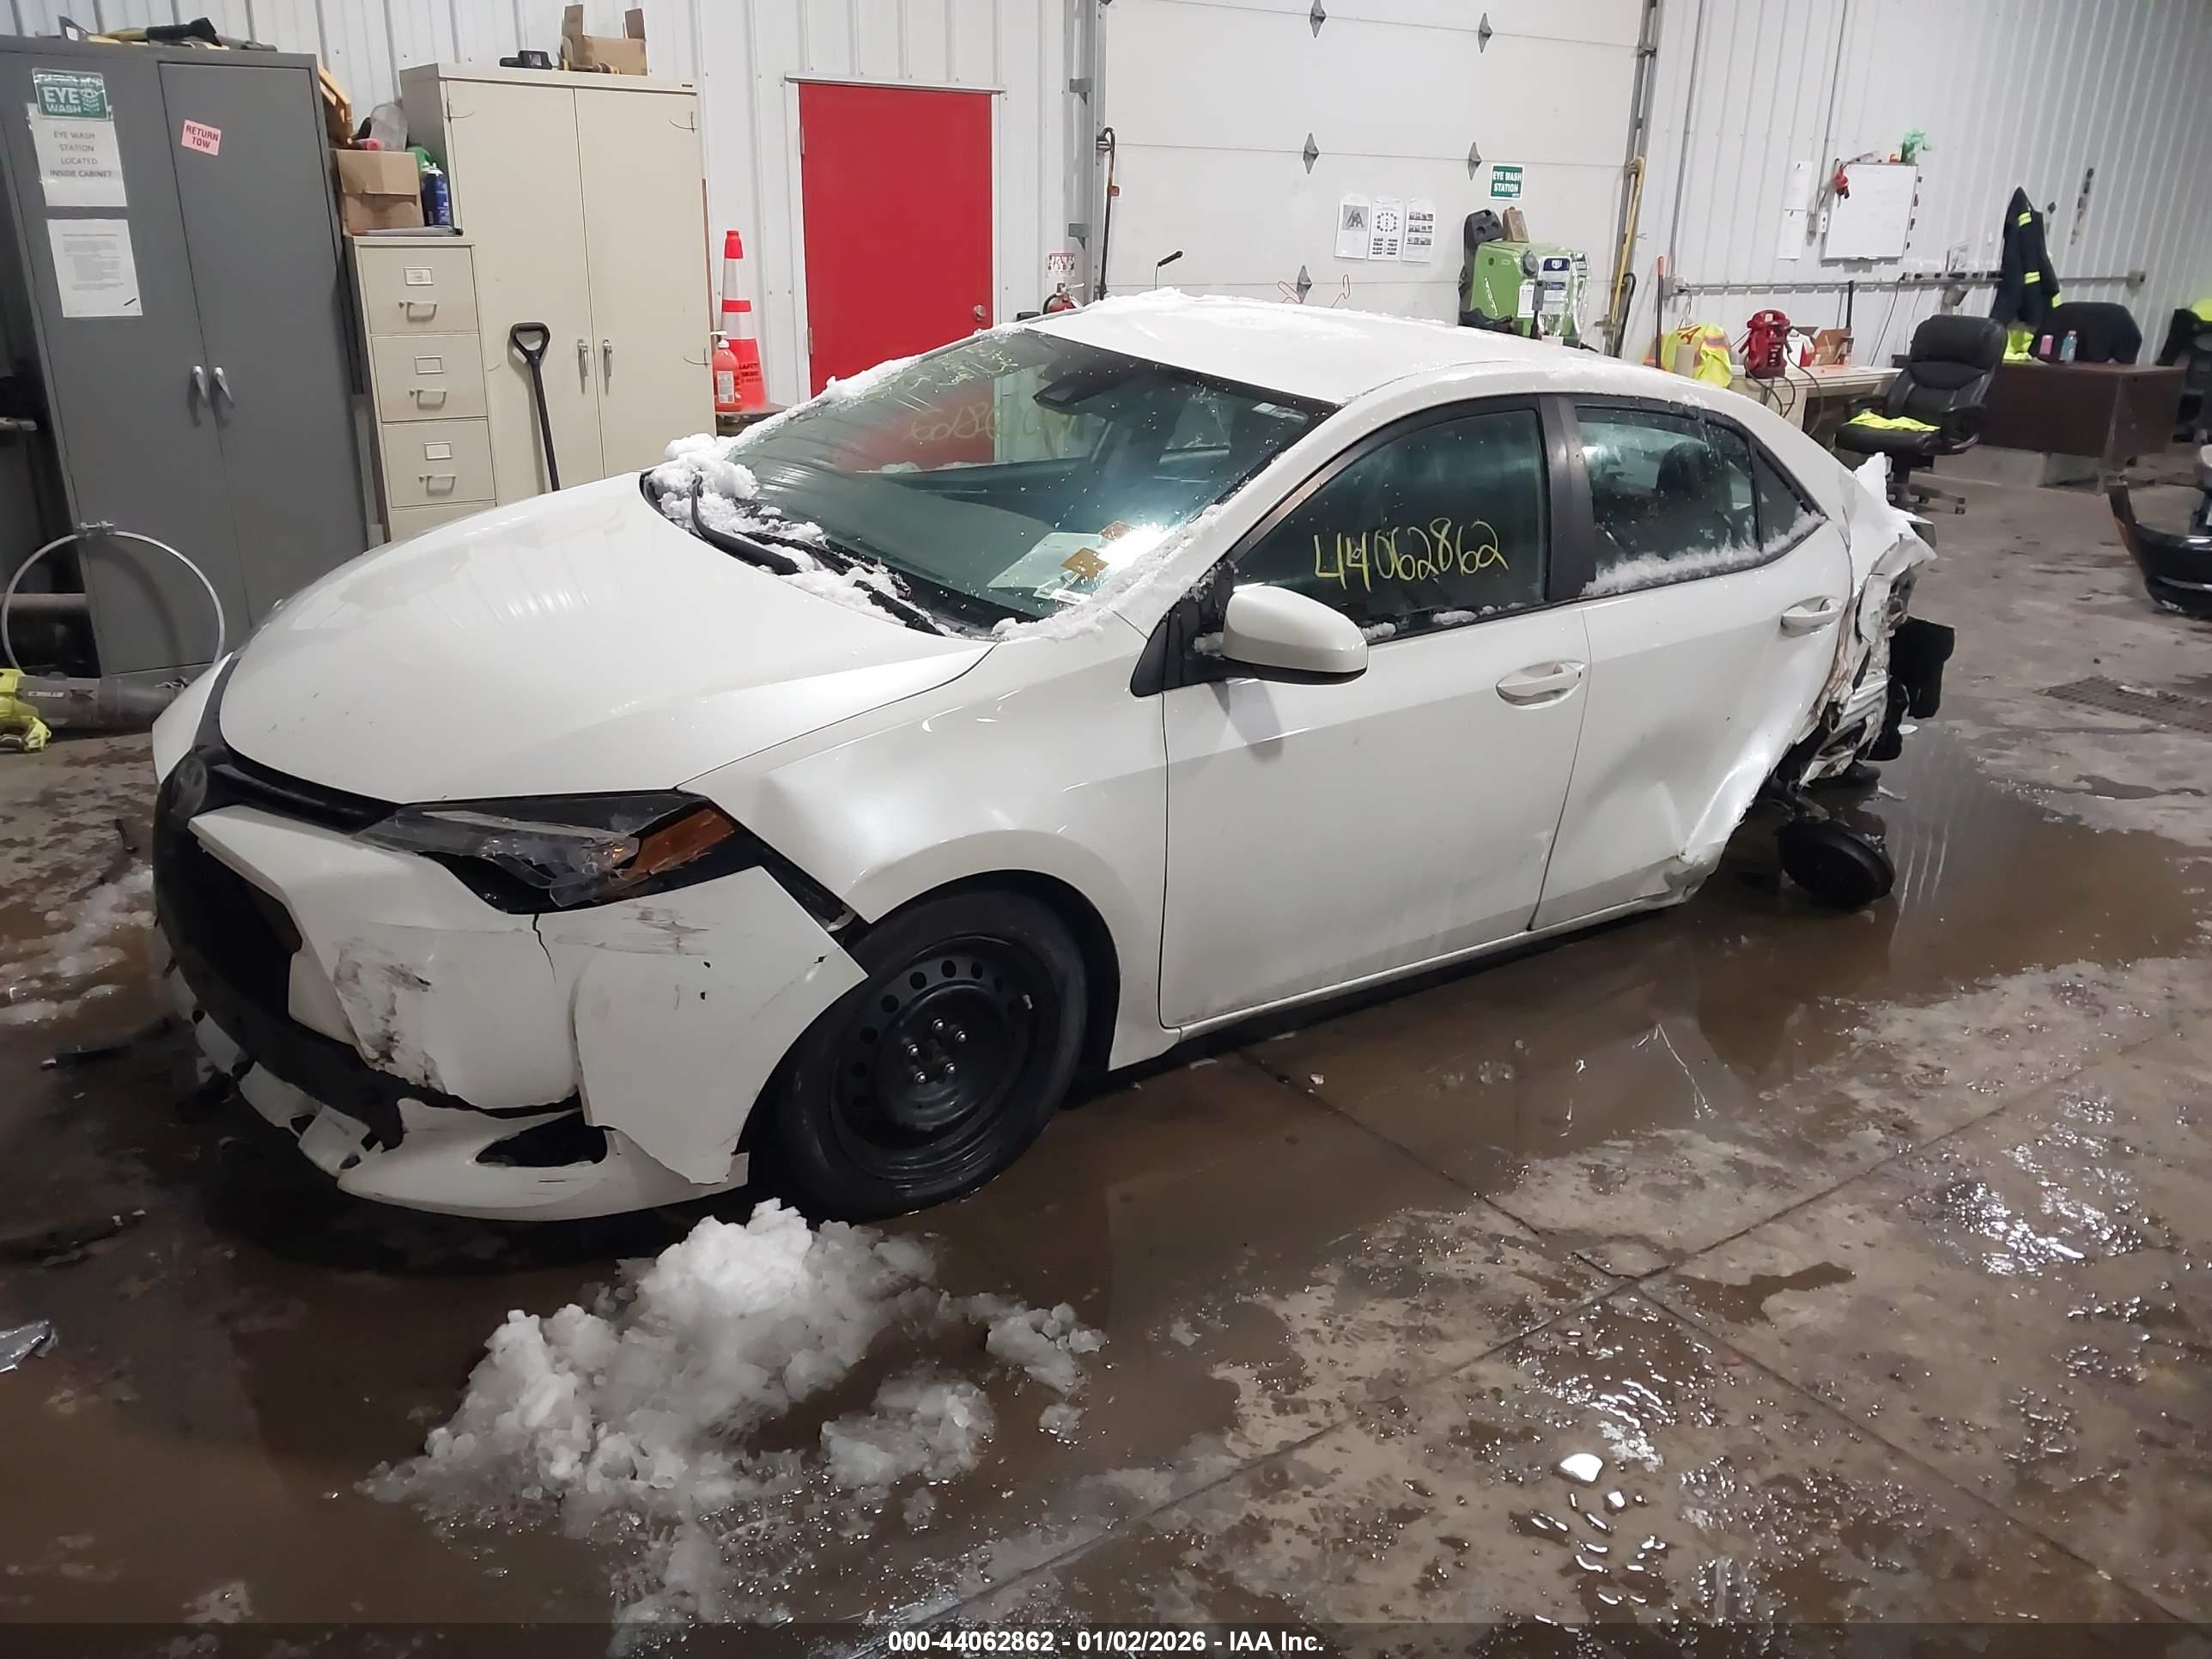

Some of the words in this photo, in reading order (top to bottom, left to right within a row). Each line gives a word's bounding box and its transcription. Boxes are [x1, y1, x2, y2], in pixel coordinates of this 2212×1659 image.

[43, 87, 80, 104] EYE
[46, 104, 82, 113] WASH
[53, 130, 68, 138] EYE
[70, 131, 95, 140] WASH
[185, 125, 219, 142] RETURN
[58, 143, 94, 152] STATION
[192, 137, 211, 149] TOW
[60, 157, 98, 166] LOCATED
[78, 170, 112, 179] CABINET
[1492, 171, 1504, 180] EYE
[1504, 172, 1522, 182] WASH
[1493, 182, 1519, 193] STATION
[1313, 517, 1509, 592] 44062862
